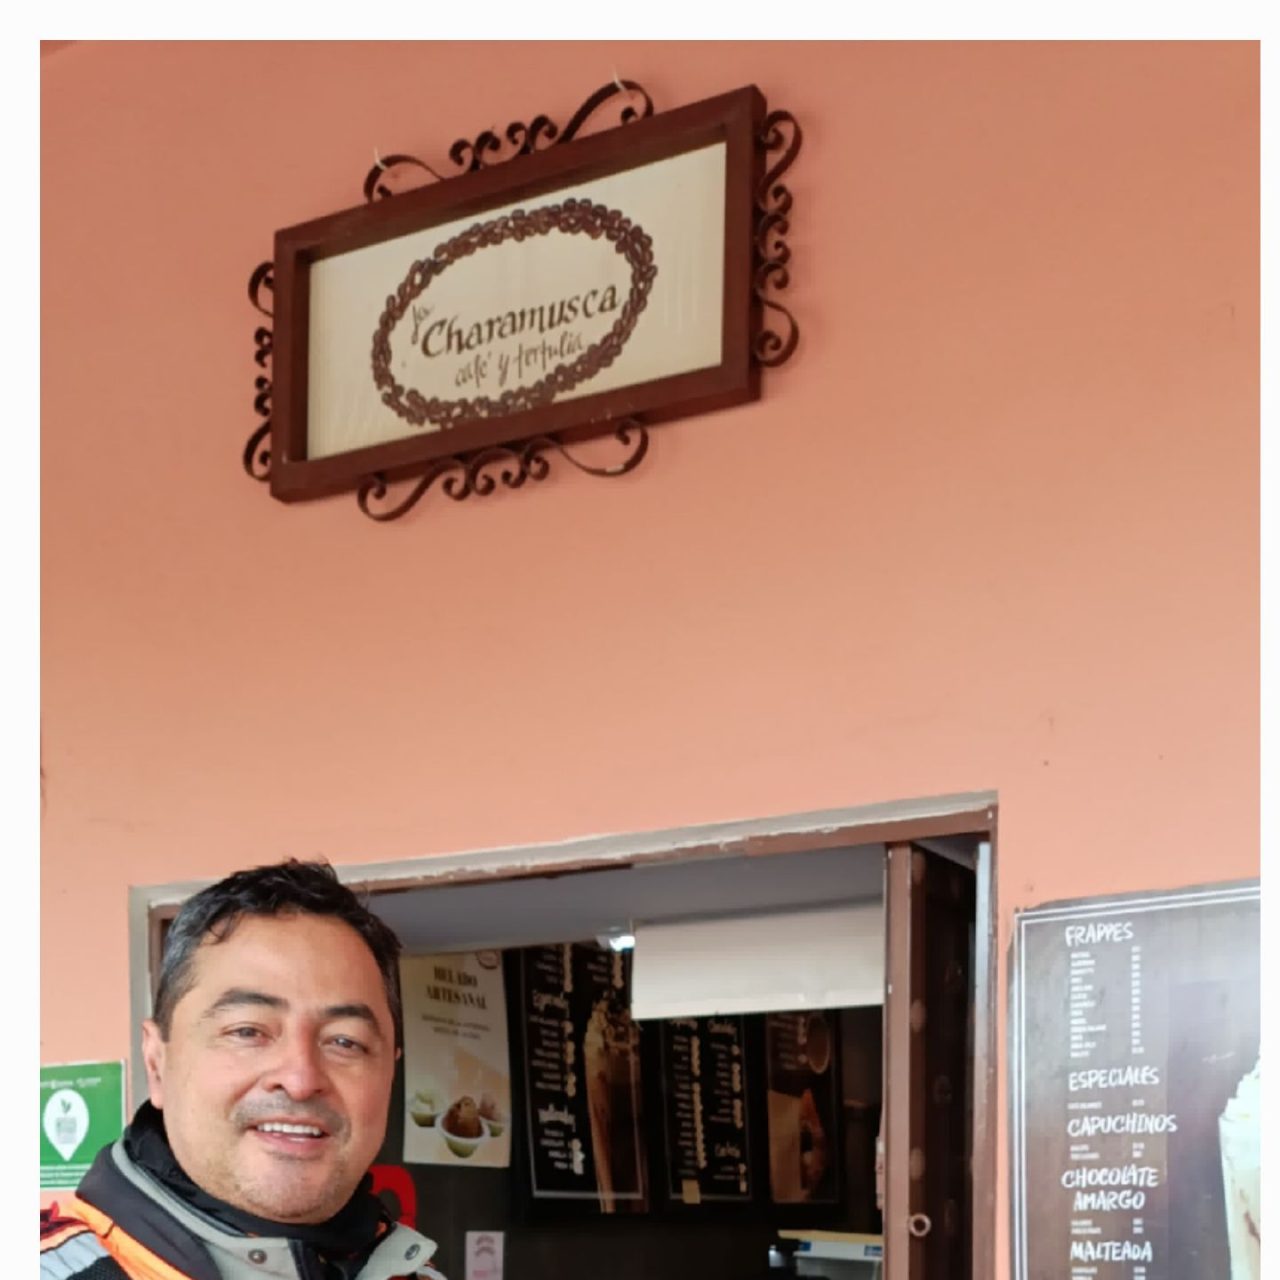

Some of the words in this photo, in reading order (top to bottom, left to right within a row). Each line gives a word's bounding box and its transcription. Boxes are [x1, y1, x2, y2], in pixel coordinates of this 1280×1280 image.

[421, 284, 619, 358] Charamusca
[498, 352, 510, 387] y
[513, 331, 584, 379] tertulia
[1065, 922, 1134, 947] FRAPPES
[1069, 1065, 1160, 1091] ESPECIALES
[1067, 1112, 1178, 1138] CAPUCHINOS
[1061, 1164, 1159, 1190] CHOCOLATE
[1073, 1189, 1145, 1212] AMARGO
[1070, 1238, 1153, 1264] MALTEADA
